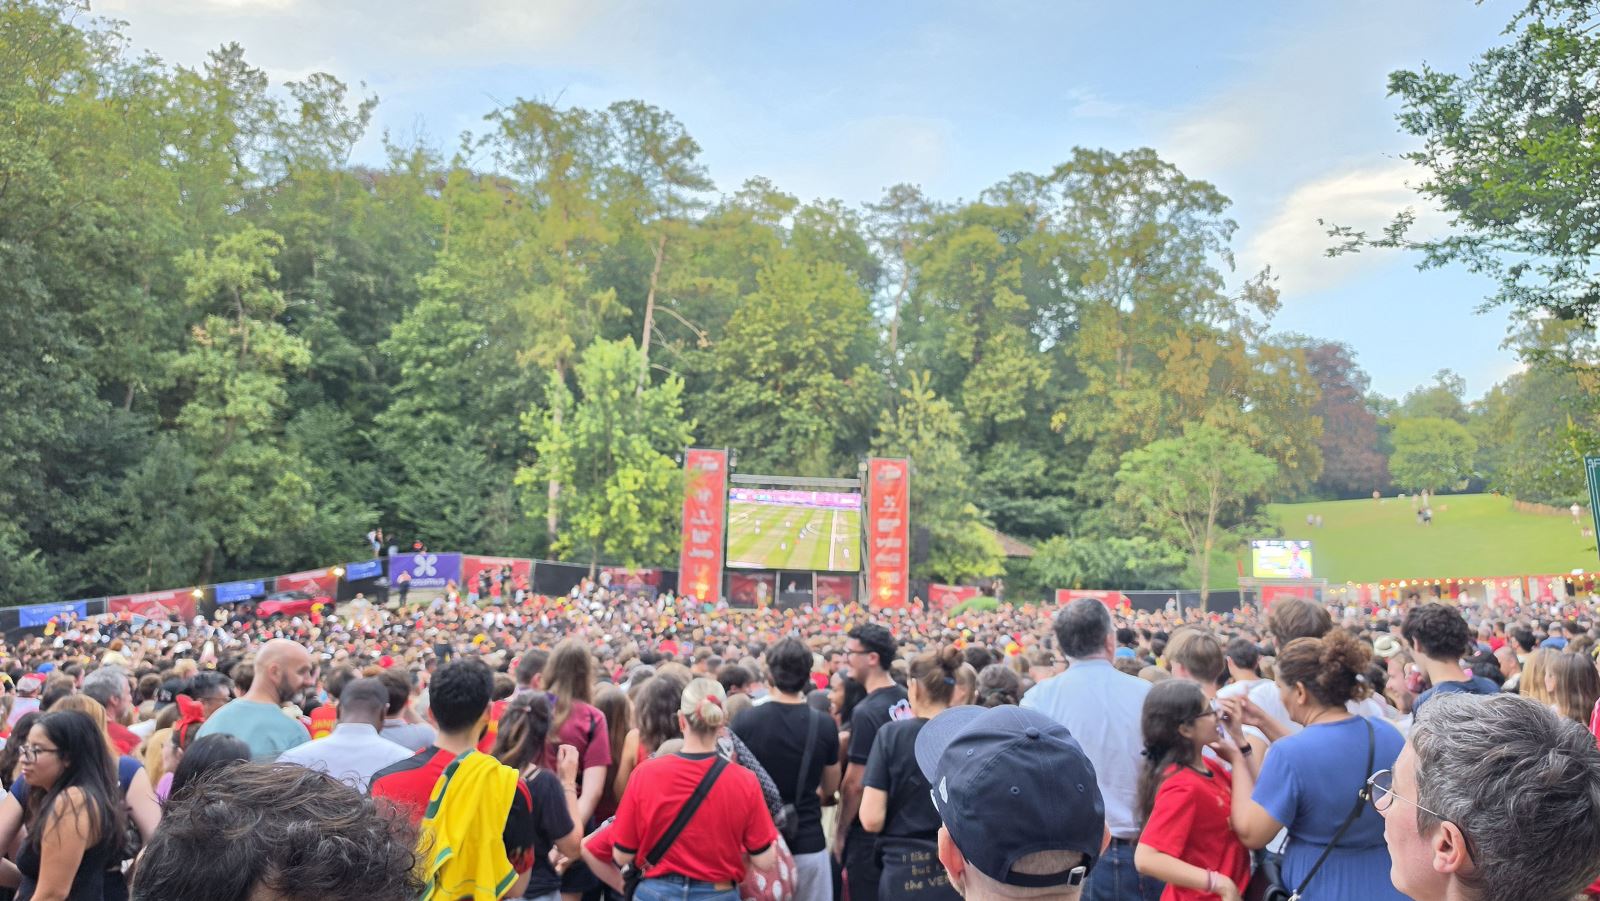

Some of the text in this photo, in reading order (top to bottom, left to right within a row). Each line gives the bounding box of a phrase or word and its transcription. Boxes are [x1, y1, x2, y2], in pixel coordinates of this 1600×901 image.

[911, 851, 930, 862] like
[912, 865, 930, 876] but
[904, 880, 923, 891] the
